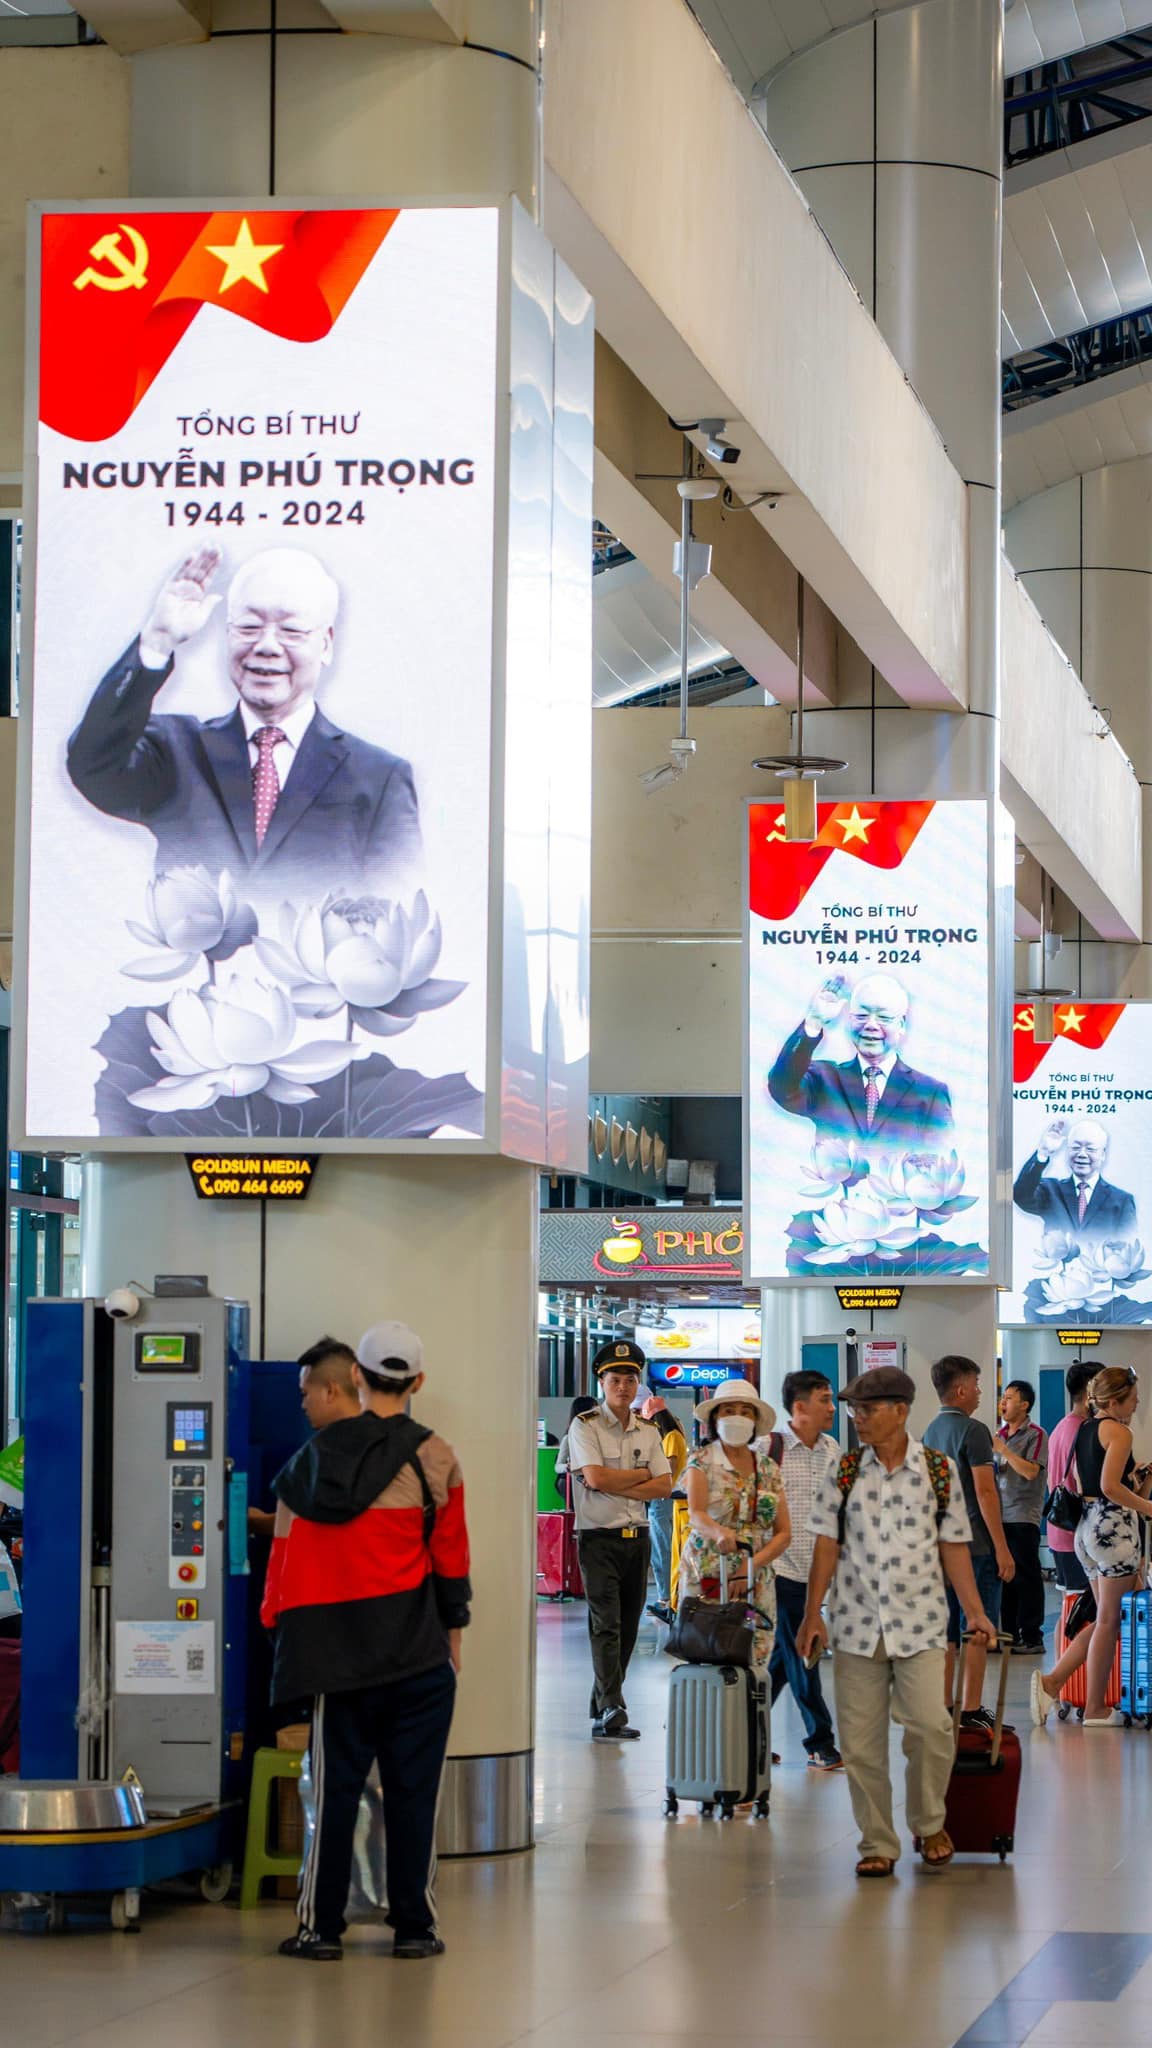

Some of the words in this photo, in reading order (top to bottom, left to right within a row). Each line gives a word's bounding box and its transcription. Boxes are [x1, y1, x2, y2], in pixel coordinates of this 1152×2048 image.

[177, 408, 256, 435] TỔNG
[266, 410, 293, 435] BÍ
[302, 410, 361, 435] THƯ
[63, 448, 225, 489] NGUYỄN
[239, 452, 322, 488] PHÚ
[335, 457, 475, 495] TRỌNG
[164, 501, 246, 527] 1944
[282, 500, 366, 526] 2024
[822, 903, 864, 918] TỔNG
[868, 904, 883, 918] BÍ
[886, 904, 919, 918] THƯ
[762, 923, 848, 945] NGUYỄN
[855, 925, 899, 945] PHÚ
[904, 928, 978, 947] TRỌNG
[816, 950, 859, 964] 1944
[877, 949, 921, 964] 2024
[1071, 1087, 1100, 1100] PHÚ
[1045, 1104, 1074, 1113] 1944
[1086, 1104, 1116, 1113] 2024
[192, 1159, 260, 1174] GOLDSUN
[263, 1160, 312, 1174] MEDIA
[214, 1179, 240, 1193] 090
[242, 1180, 268, 1193] 464
[270, 1180, 304, 1194] 6699
[838, 1289, 874, 1297] GOLDSUN
[875, 1289, 901, 1297] MEDIA
[691, 1367, 729, 1381] pepsi
